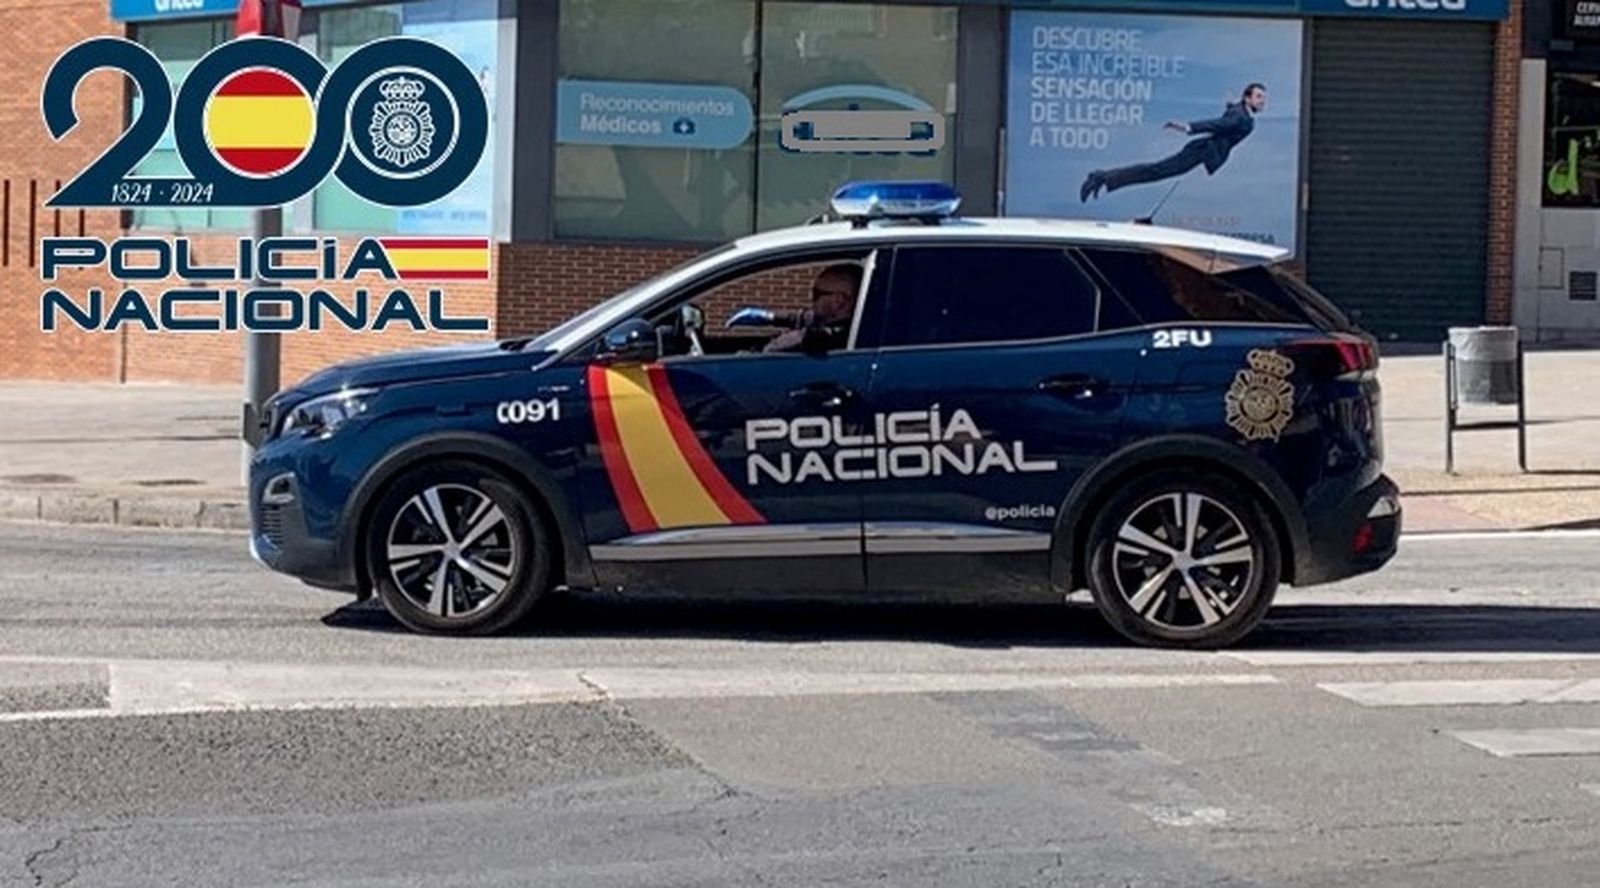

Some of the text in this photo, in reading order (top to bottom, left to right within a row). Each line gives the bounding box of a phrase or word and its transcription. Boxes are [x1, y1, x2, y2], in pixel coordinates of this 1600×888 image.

[1032, 26, 1142, 51] DESCUBRE
[1031, 52, 1072, 74] ESA
[1031, 75, 1152, 101] SENSACIÓN
[580, 92, 735, 117] Reconocimientos
[1030, 102, 1145, 125] DE LLEGAR
[580, 114, 662, 135] Médicos
[1029, 126, 1110, 149] A TODO
[1152, 330, 1212, 348] 2FU
[745, 402, 982, 451] POLICÍA
[747, 440, 1058, 485] NACIONAL
[984, 503, 1056, 521] @policia
